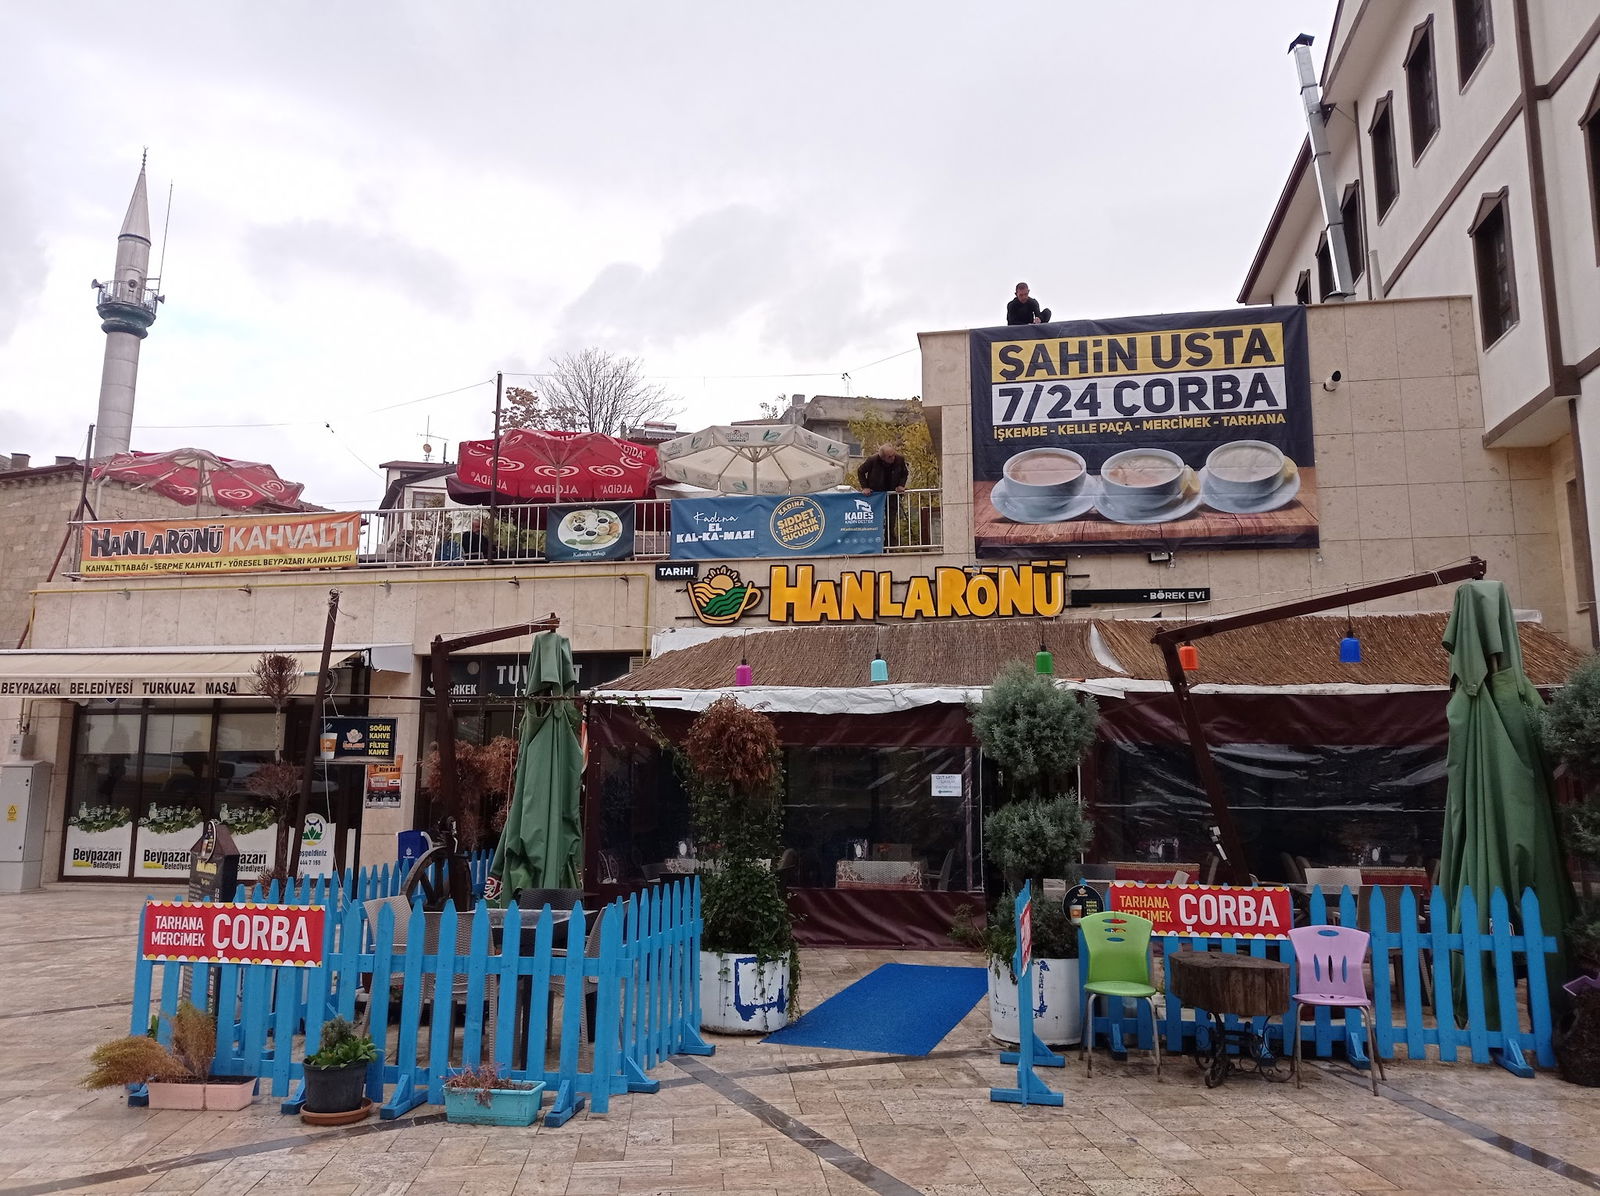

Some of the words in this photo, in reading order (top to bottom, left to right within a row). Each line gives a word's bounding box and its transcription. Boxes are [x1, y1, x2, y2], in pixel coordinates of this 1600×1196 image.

[1151, 328, 1276, 369] USTA
[998, 382, 1101, 424] 7/24
[1113, 372, 1279, 417] ÇORBA
[1058, 422, 1097, 436] KELLE
[1100, 420, 1132, 436] PAÇA
[1221, 413, 1286, 427] TARHANA
[778, 500, 805, 516] KADINA
[708, 523, 722, 532] EL
[90, 524, 225, 558] HANLARÖNÜ
[229, 522, 355, 552] KAHVALTI
[676, 530, 754, 544] KAL-KA-MAZ!
[86, 564, 121, 572] KAHVALTI
[121, 563, 148, 571] TABAĞI
[185, 561, 221, 569] KAHVALTI
[228, 558, 261, 567] YÖRESEL
[264, 557, 305, 566] BEYPAZARI
[307, 555, 352, 564] KAHVALTISI
[768, 560, 1067, 622] HANLARÖNÜ
[1150, 590, 1185, 600] BÖREK
[1, 682, 60, 694] BEYPAZARI
[70, 680, 133, 694] BELEDİYESİ
[142, 682, 196, 694] TURKUAZ
[206, 681, 237, 694] MASA
[73, 848, 122, 864] Beypazarı
[93, 861, 120, 869] Belediyesi
[1120, 896, 1170, 909] TARHANA
[1179, 894, 1279, 932] ÇORBA
[156, 915, 204, 931] TARHANA
[212, 914, 310, 958] ÇORBA
